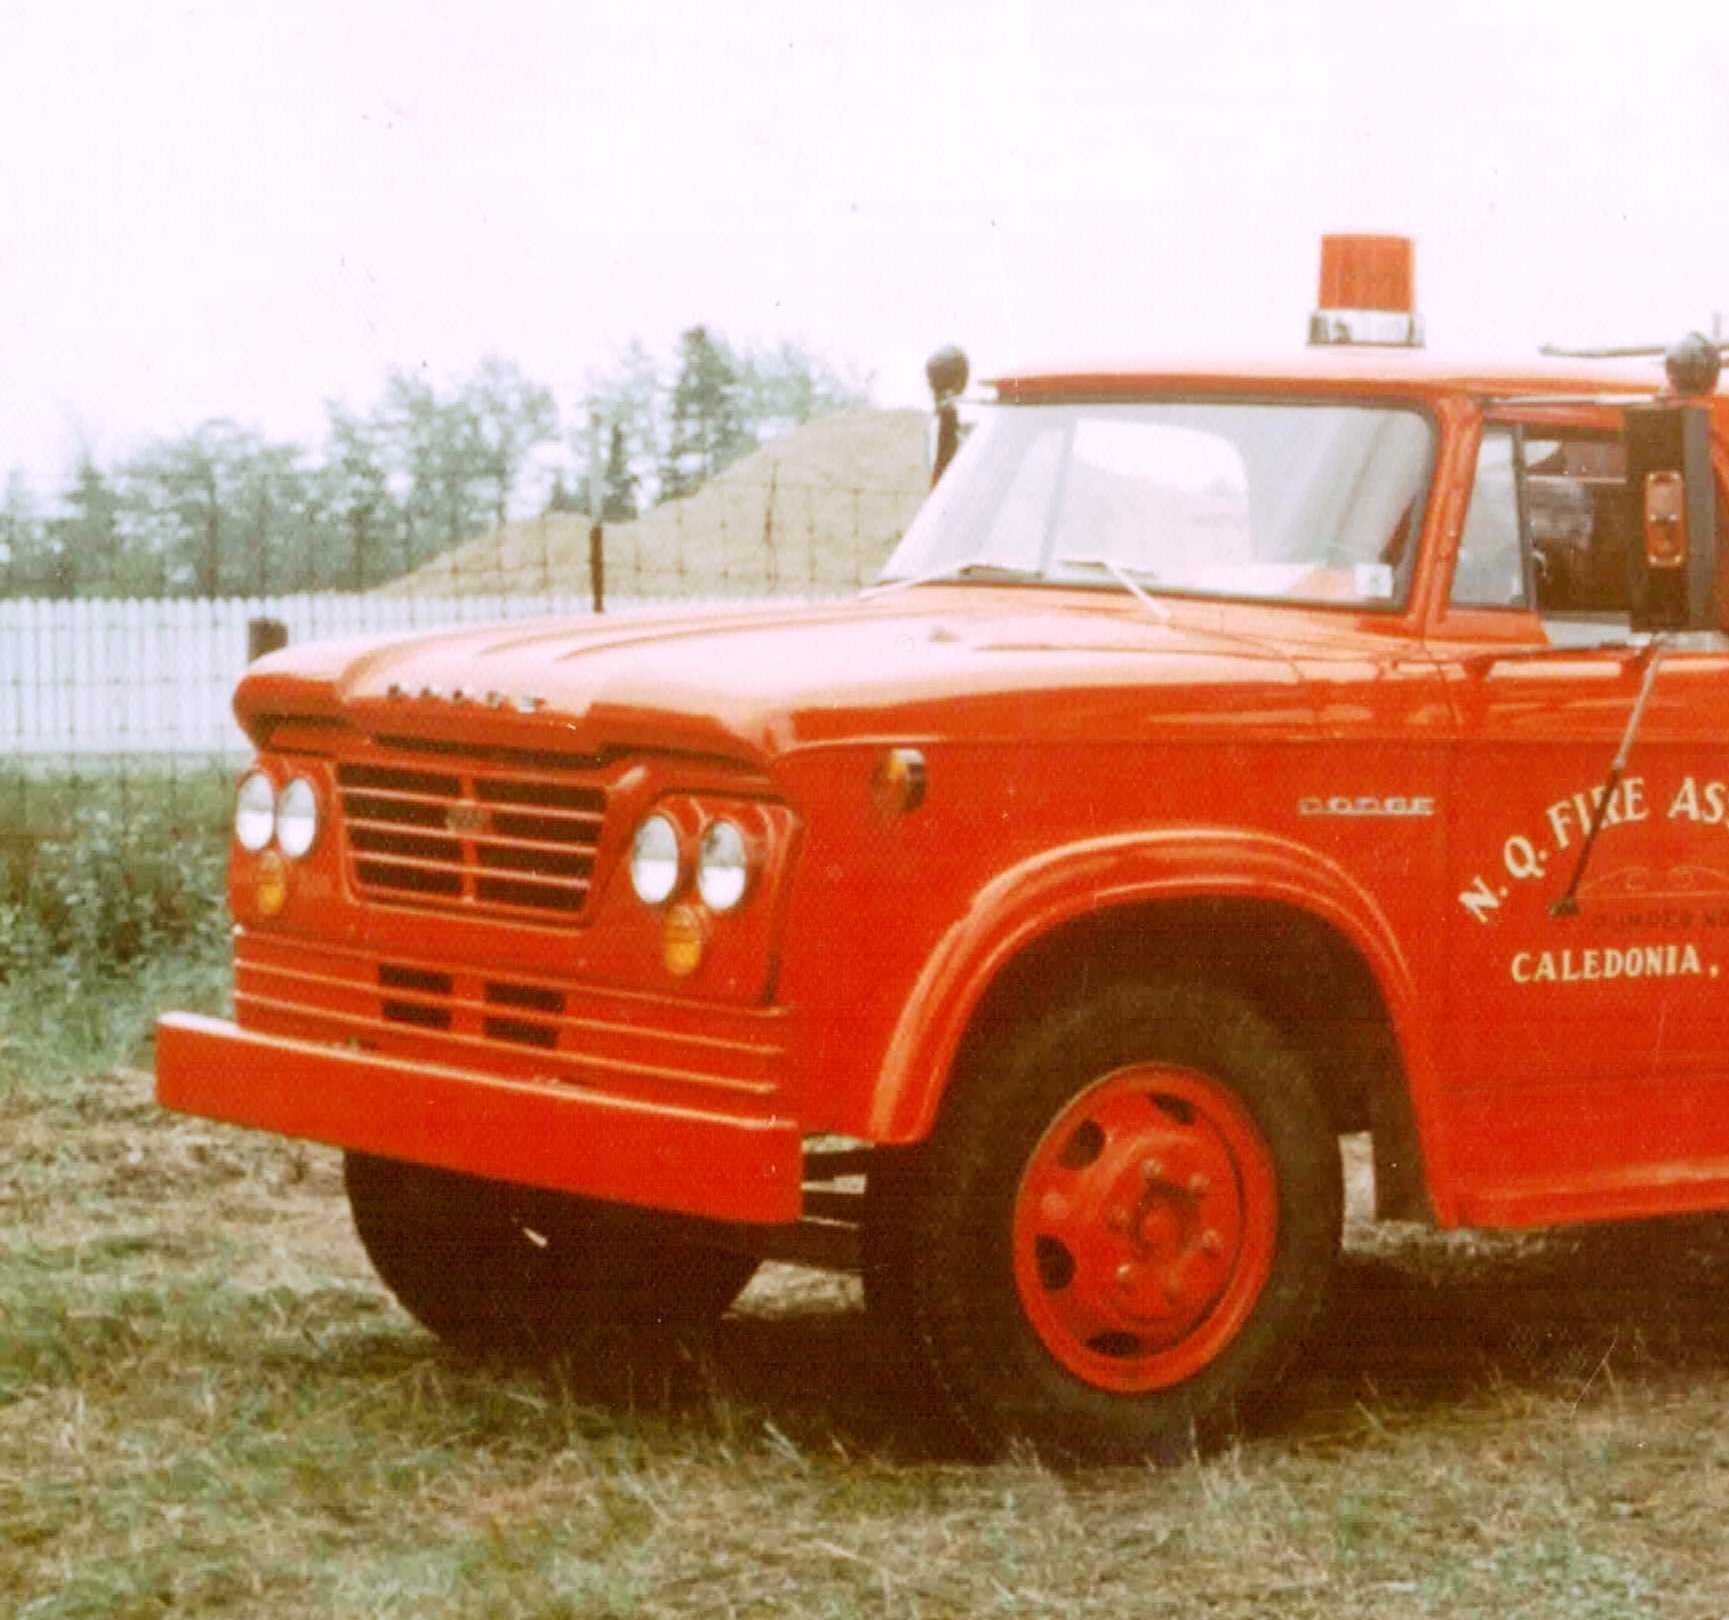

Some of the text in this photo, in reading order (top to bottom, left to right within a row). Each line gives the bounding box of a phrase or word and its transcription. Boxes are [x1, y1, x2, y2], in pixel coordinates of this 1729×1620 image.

[1297, 795, 1437, 816] DODGE
[1458, 875, 1509, 923] N.
[1503, 835, 1548, 879] Q.
[1546, 776, 1649, 850] FIRE
